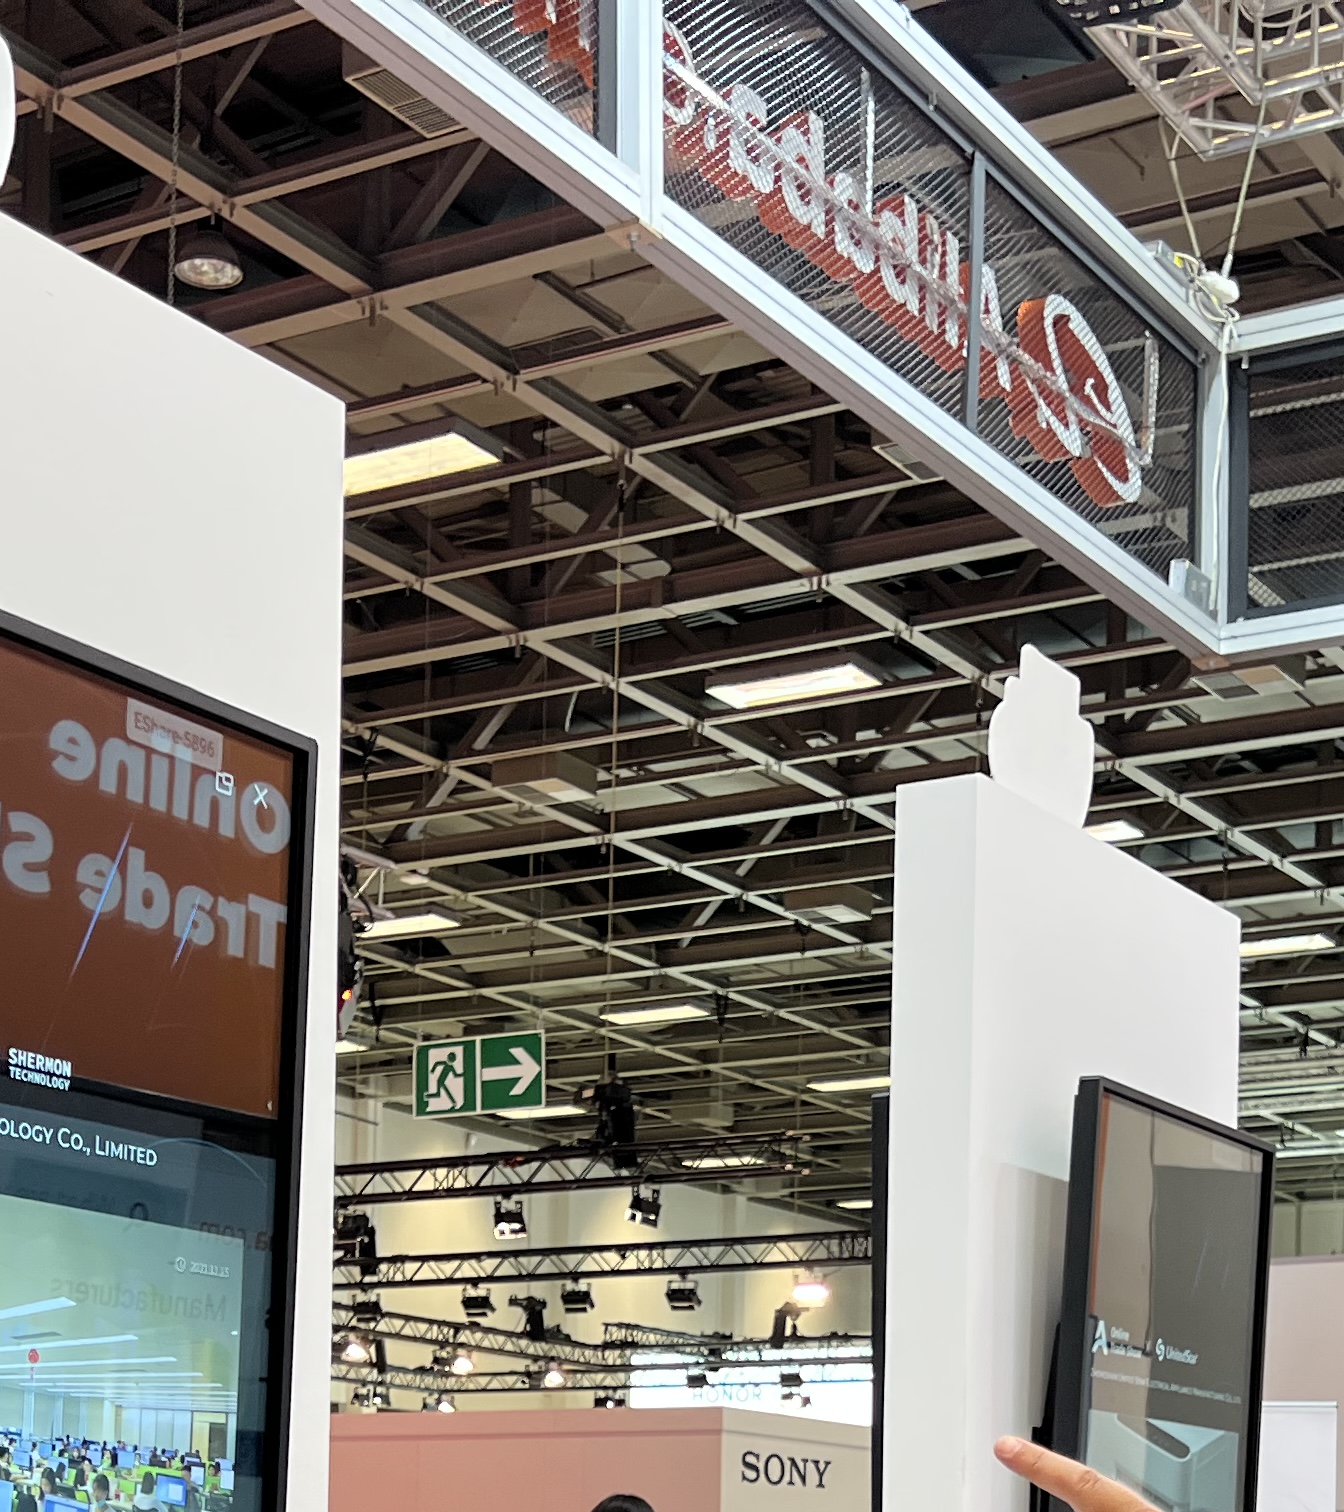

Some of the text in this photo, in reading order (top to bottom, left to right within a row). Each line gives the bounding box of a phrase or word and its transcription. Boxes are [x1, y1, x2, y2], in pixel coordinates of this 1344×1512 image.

[8, 1047, 72, 1078] SHERMON
[8, 1066, 71, 1092] TECHNOLOGY
[95, 1135, 158, 1167] LIMITED
[692, 1383, 762, 1402] HONOR
[741, 1450, 832, 1489] SONY
